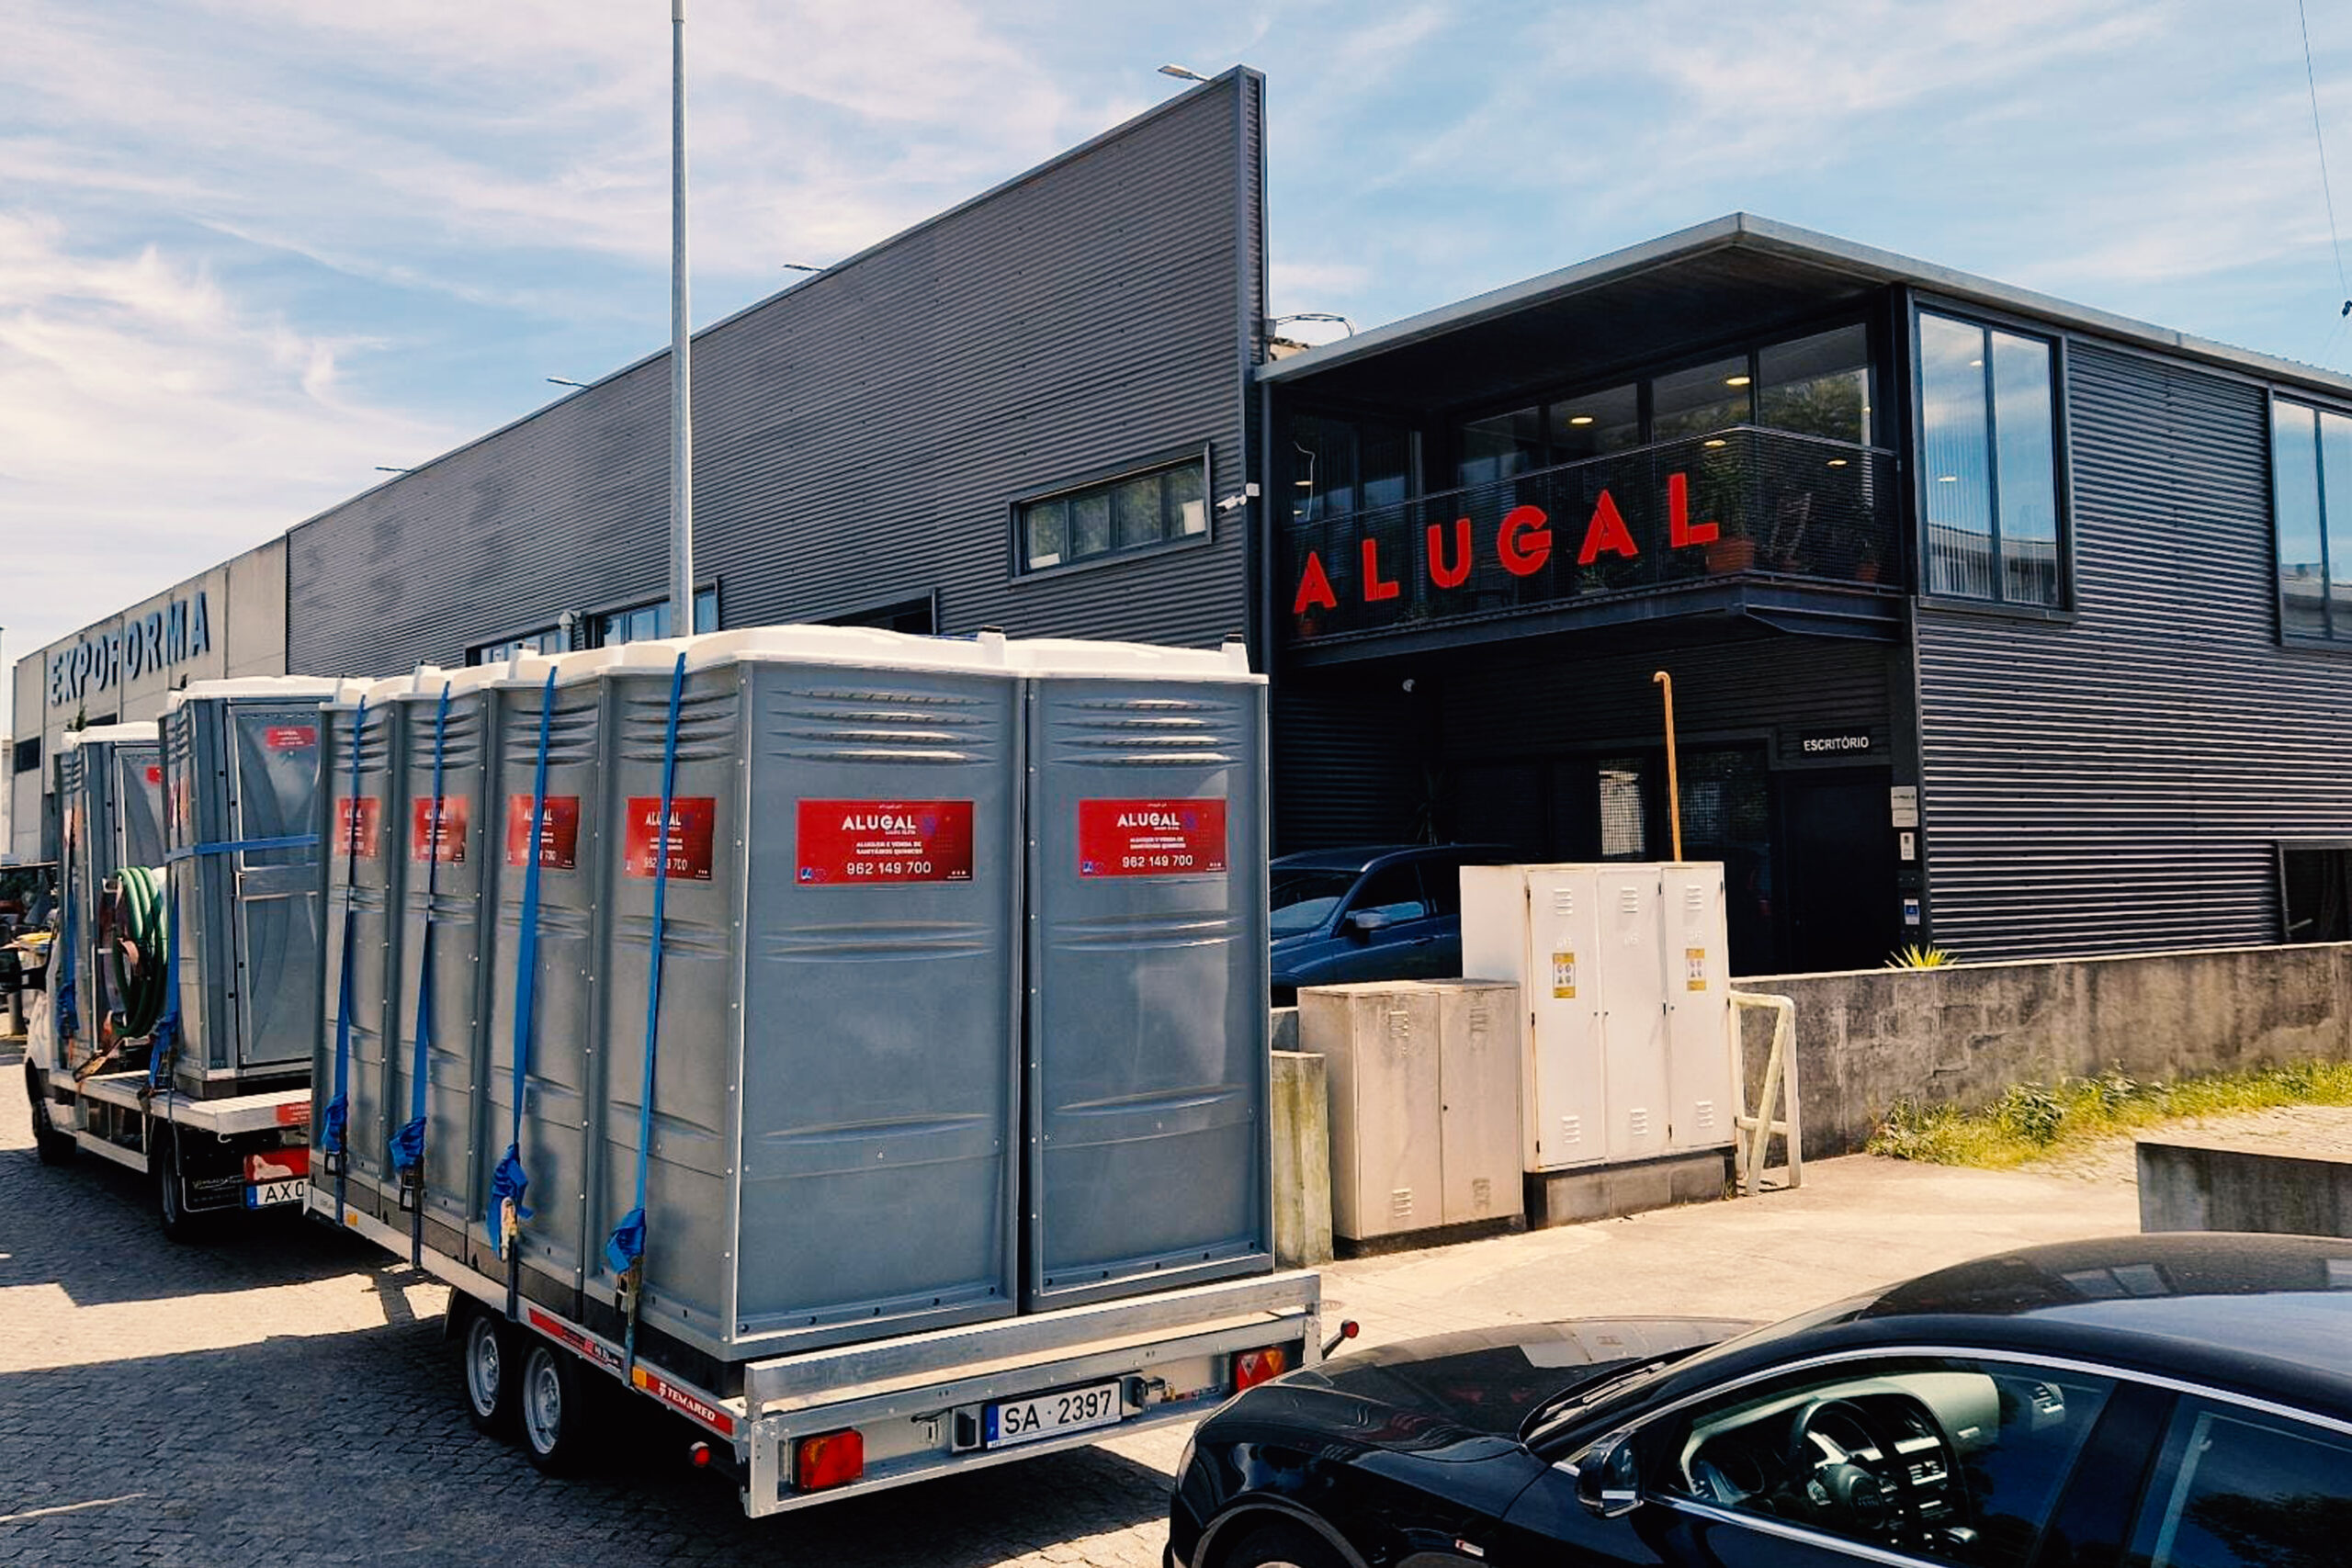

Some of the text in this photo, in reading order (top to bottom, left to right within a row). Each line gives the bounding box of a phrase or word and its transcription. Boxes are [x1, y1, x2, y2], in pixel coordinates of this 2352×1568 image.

[1293, 472, 1719, 614] ALUGAL
[50, 591, 210, 706] EXPOFORMA
[1804, 736, 1870, 751] ESCRITÓRIO
[842, 815, 917, 830] ALUGAL
[1117, 812, 1181, 828] ALUGAL
[846, 861, 932, 874] 962 149 700
[1122, 854, 1193, 868] 962 149 700
[667, 1387, 716, 1422] TEMARED
[1004, 1390, 1112, 1434] SA 2397
